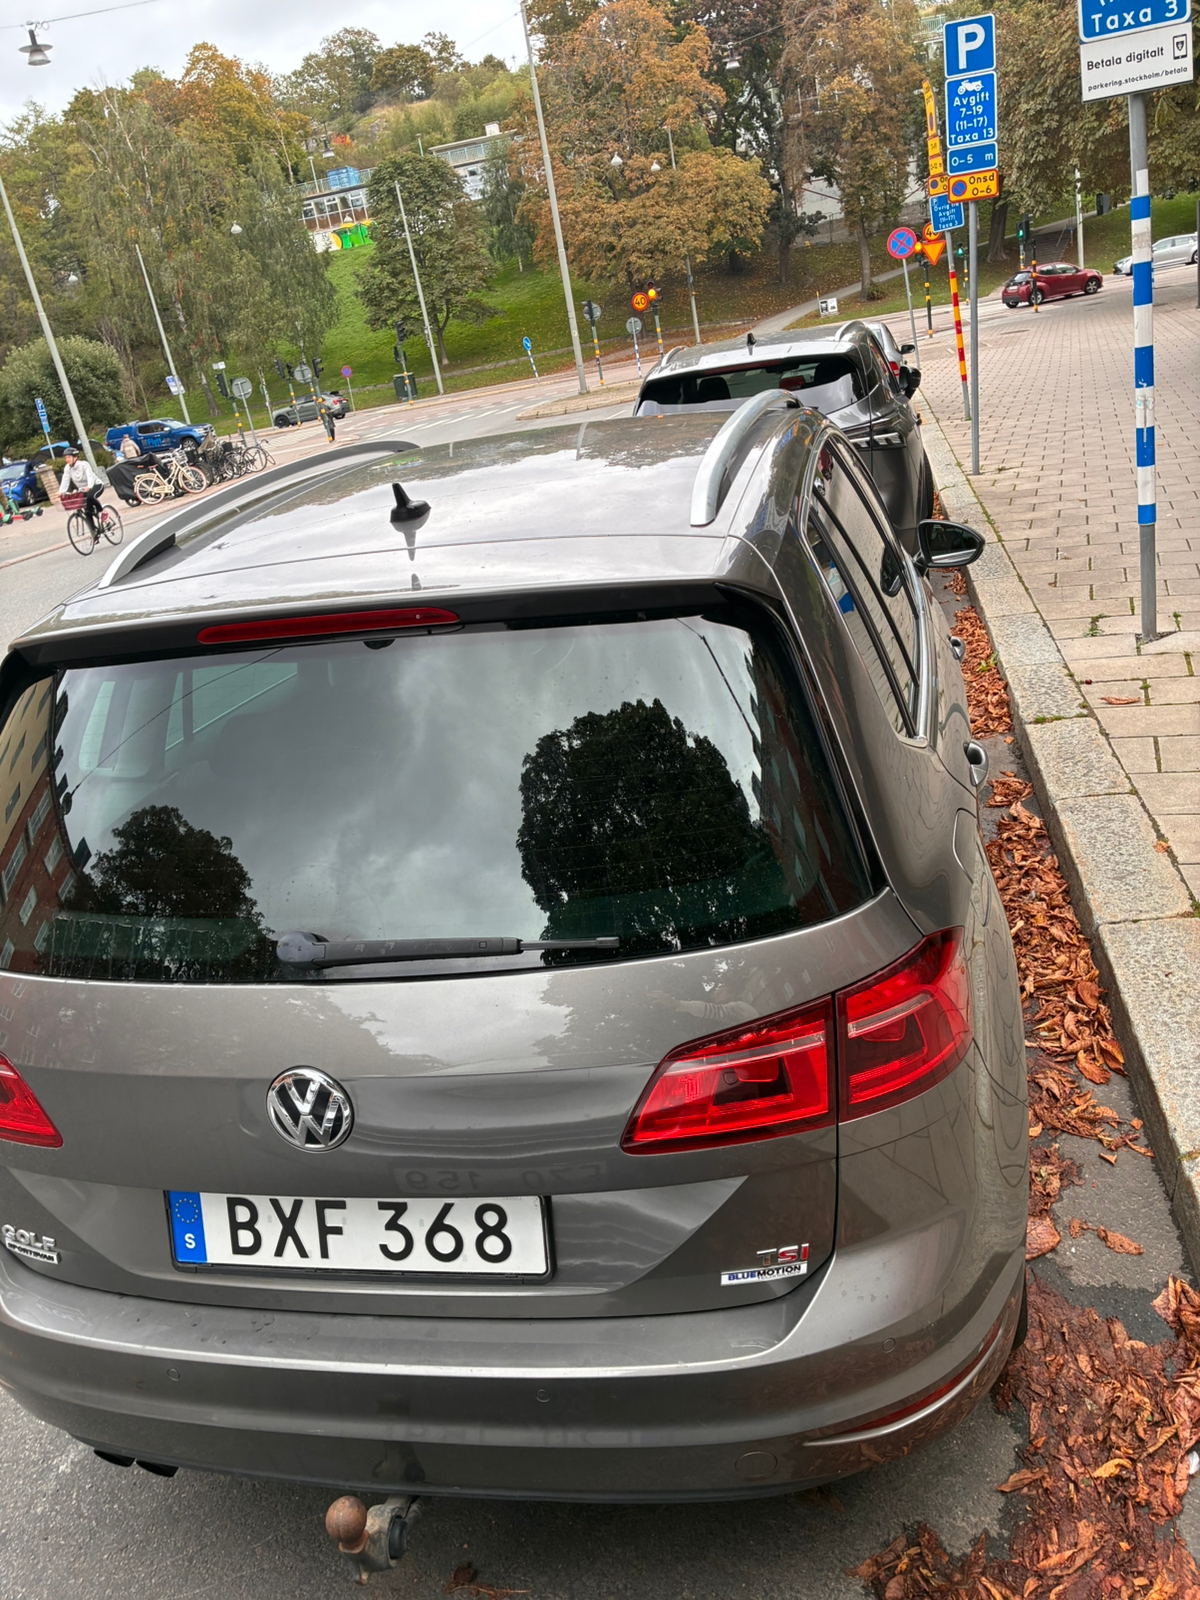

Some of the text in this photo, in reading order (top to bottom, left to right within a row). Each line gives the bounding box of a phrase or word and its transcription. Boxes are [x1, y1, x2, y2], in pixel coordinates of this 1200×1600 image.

[1090, 0, 1178, 33] Taxa 3
[957, 23, 985, 70] P
[1086, 46, 1164, 71] Betala digitalt
[1087, 66, 1188, 92] parkering.stockholm/betala
[953, 91, 990, 107] Avgift
[959, 105, 983, 118] 7-19
[955, 115, 988, 132] (11-17)
[950, 127, 994, 144] Taxa 13
[951, 153, 974, 167] 0-5
[984, 152, 994, 161] m
[968, 172, 995, 185] Onsd
[971, 184, 992, 196] 0-6
[634, 296, 647, 307] 40
[1, 1224, 56, 1250] GOLF
[226, 1196, 512, 1263] BXF 368
[184, 1233, 196, 1249] S
[756, 1243, 810, 1266] TSI
[728, 1264, 801, 1281] BLUEMOTION
